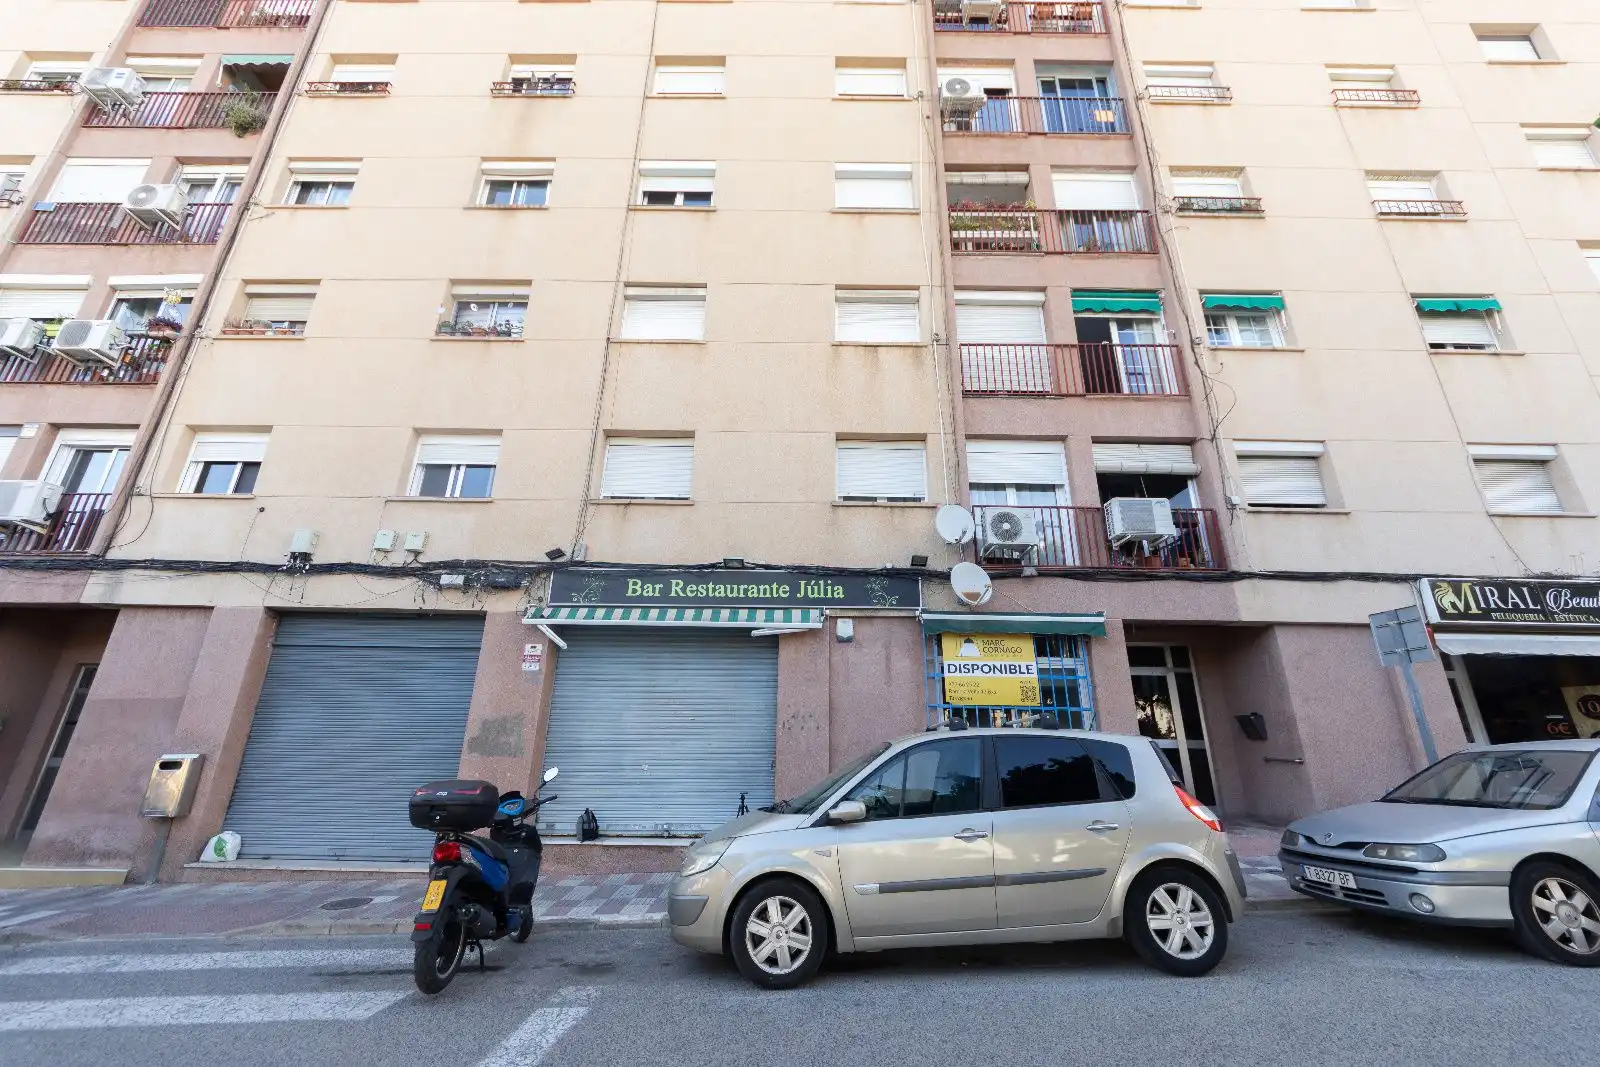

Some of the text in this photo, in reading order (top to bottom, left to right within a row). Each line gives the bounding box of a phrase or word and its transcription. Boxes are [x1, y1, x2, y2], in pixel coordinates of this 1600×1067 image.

[625, 578, 845, 599] Bar Restaurante Júlia
[1434, 582, 1541, 614] MIRAL
[1490, 612, 1545, 622] PELUQUERIA
[982, 639, 1006, 647] MARC
[982, 646, 1023, 654] CORNAGO
[947, 663, 1035, 675] DISPONIBLE
[1306, 867, 1349, 885] T 8327 BF
